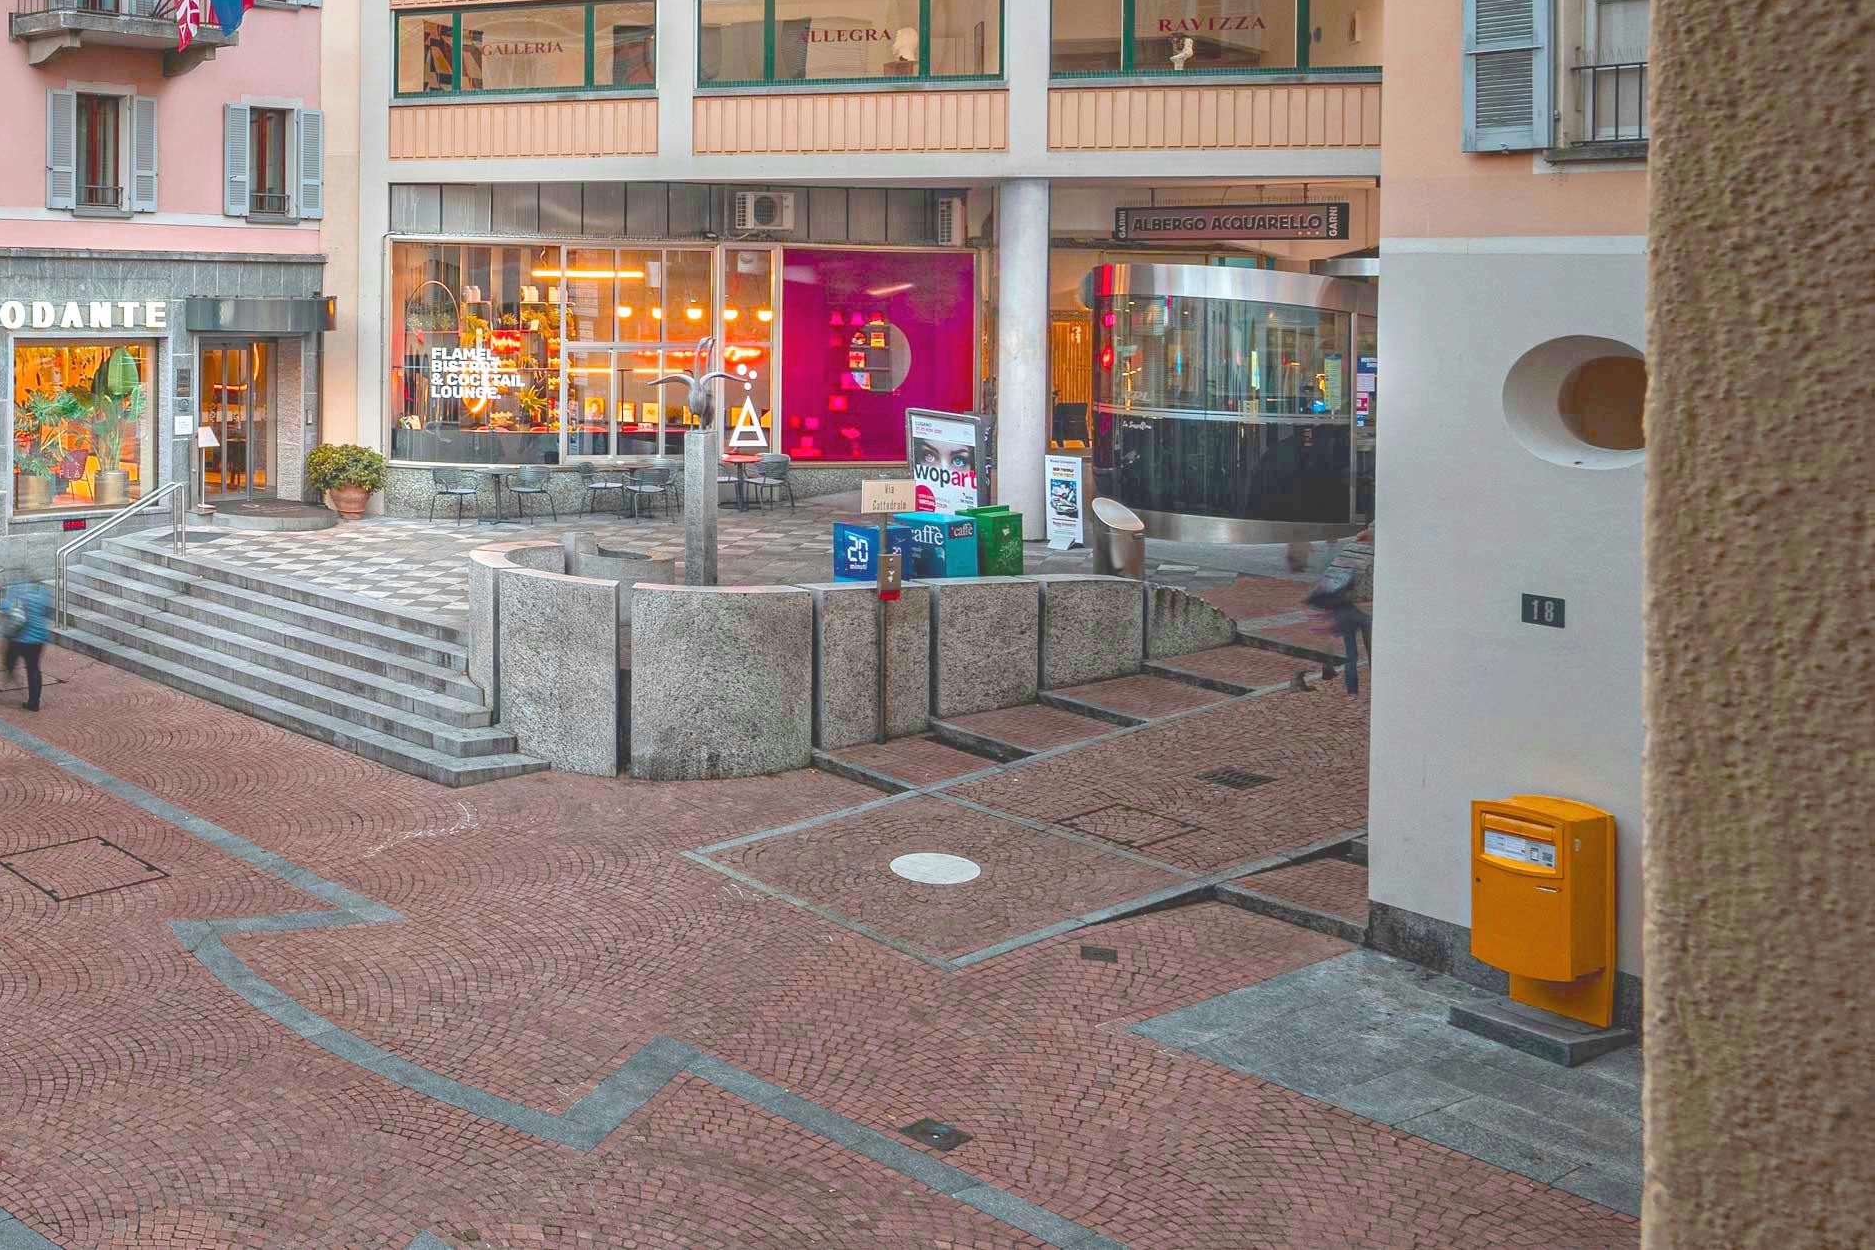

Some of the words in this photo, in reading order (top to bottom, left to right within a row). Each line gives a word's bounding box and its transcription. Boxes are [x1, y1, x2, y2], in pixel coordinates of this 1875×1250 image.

[1158, 16, 1266, 31] RAVIZZA
[800, 28, 891, 43] ALLEGRA
[482, 40, 563, 56] GALLERIA
[1118, 211, 1127, 239] GARNI
[1133, 216, 1207, 232] ALBERGO
[1211, 213, 1323, 231] ACQUARELLO
[1328, 206, 1338, 237] GARNI
[431, 359, 501, 373] BISTROT
[431, 373, 444, 386] &
[447, 373, 525, 387] COCKTAIL
[431, 386, 502, 399] LOUNGE.
[915, 463, 978, 490] wopart
[884, 483, 895, 494] Via
[847, 535, 869, 563] 20
[1530, 599, 1555, 622] 18
